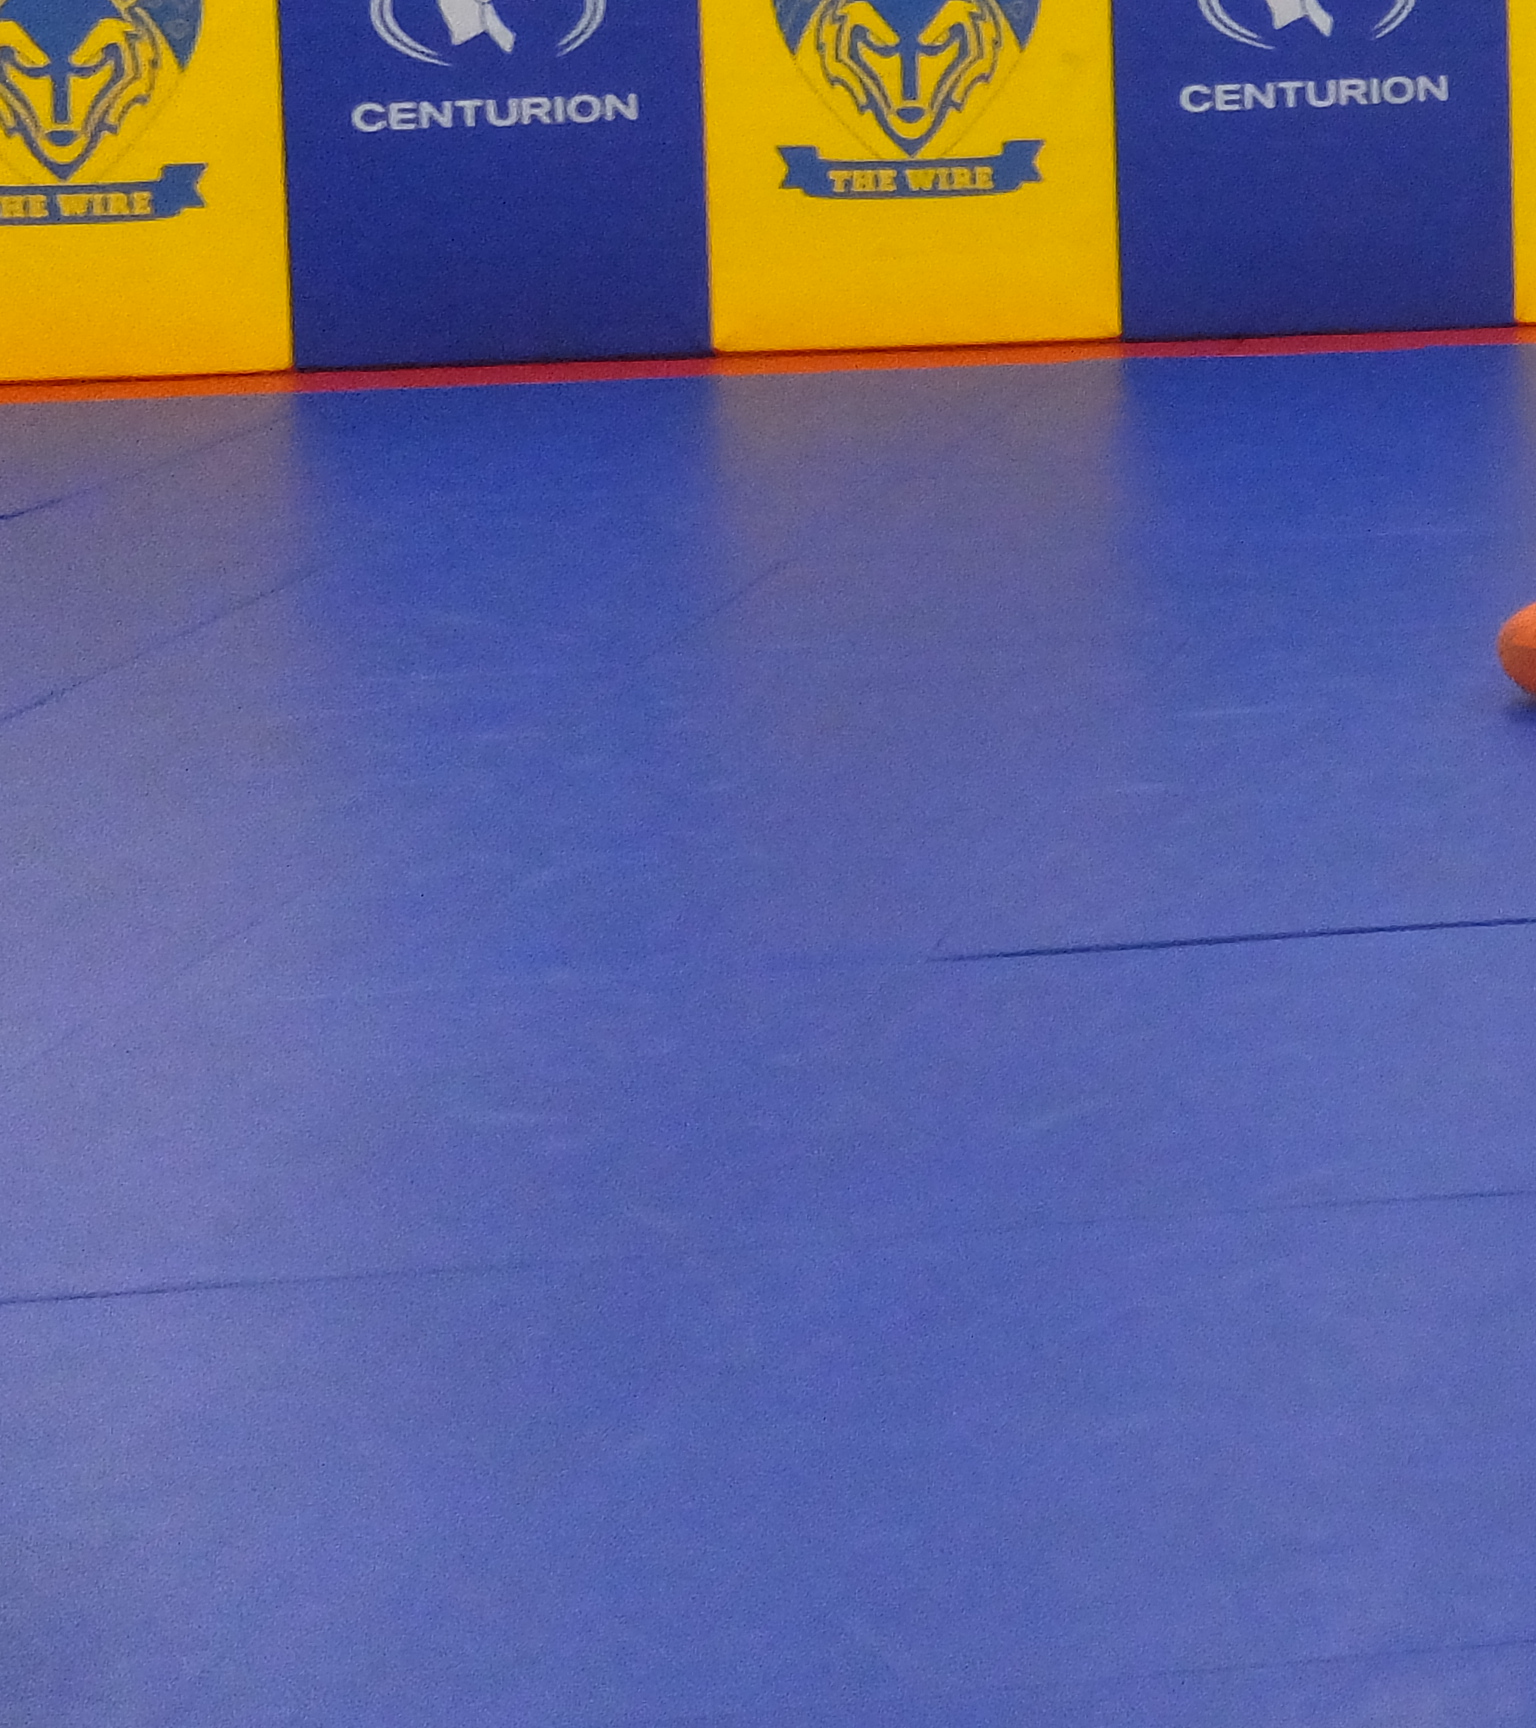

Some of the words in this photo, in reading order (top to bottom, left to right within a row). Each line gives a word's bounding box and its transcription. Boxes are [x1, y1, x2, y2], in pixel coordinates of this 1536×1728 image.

[350, 92, 640, 133] CENTURION
[1178, 74, 1450, 113] CENTURION
[828, 170, 898, 193] THE
[905, 167, 995, 191] WIRE
